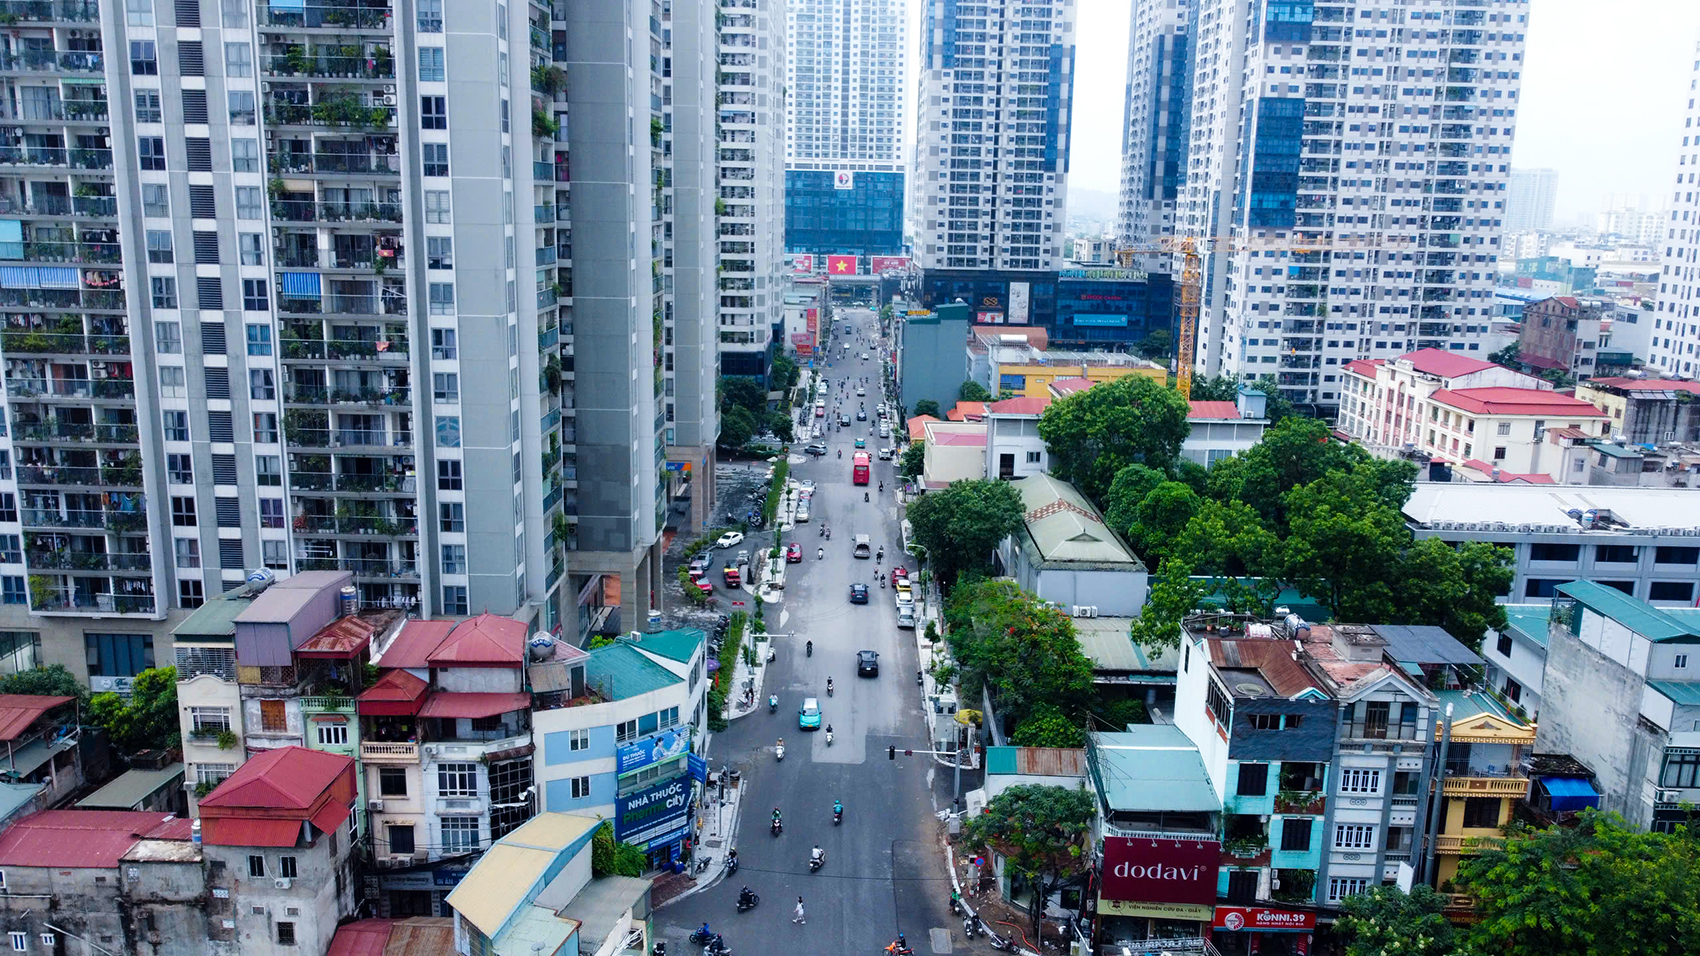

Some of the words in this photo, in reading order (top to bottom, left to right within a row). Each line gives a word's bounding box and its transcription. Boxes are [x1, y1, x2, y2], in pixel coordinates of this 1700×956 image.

[628, 794, 649, 811] NHÀ
[649, 782, 683, 803] THUỐC
[623, 793, 686, 826] Pharmacity
[1113, 860, 1199, 881] dodavi
[1256, 912, 1306, 922] KONNI.39
